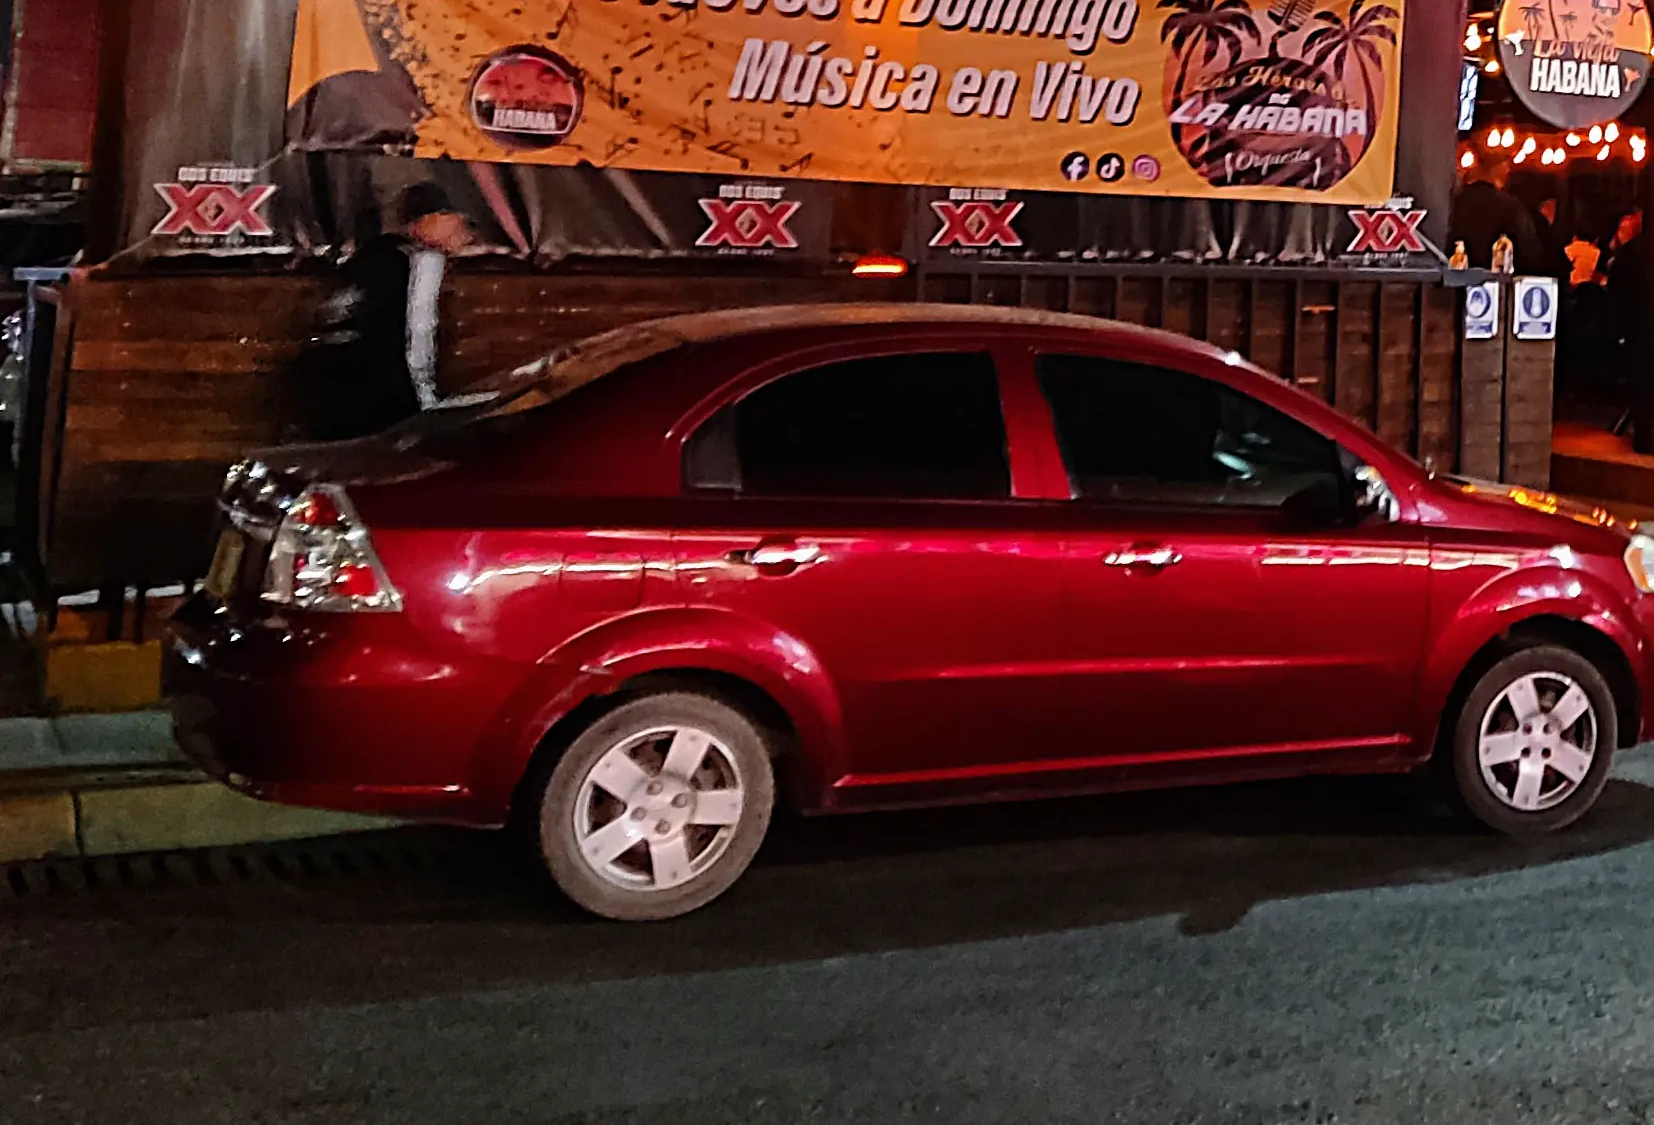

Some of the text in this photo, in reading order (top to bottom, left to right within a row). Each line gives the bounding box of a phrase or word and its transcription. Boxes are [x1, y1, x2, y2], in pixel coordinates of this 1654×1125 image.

[727, 38, 1141, 126] Música en Vivo
[1530, 57, 1621, 99] HABANA
[1168, 97, 1368, 138] LA HABANA
[151, 183, 277, 236] XX
[695, 199, 802, 248] XX
[928, 201, 1024, 246] XX
[1347, 210, 1427, 252] XX
